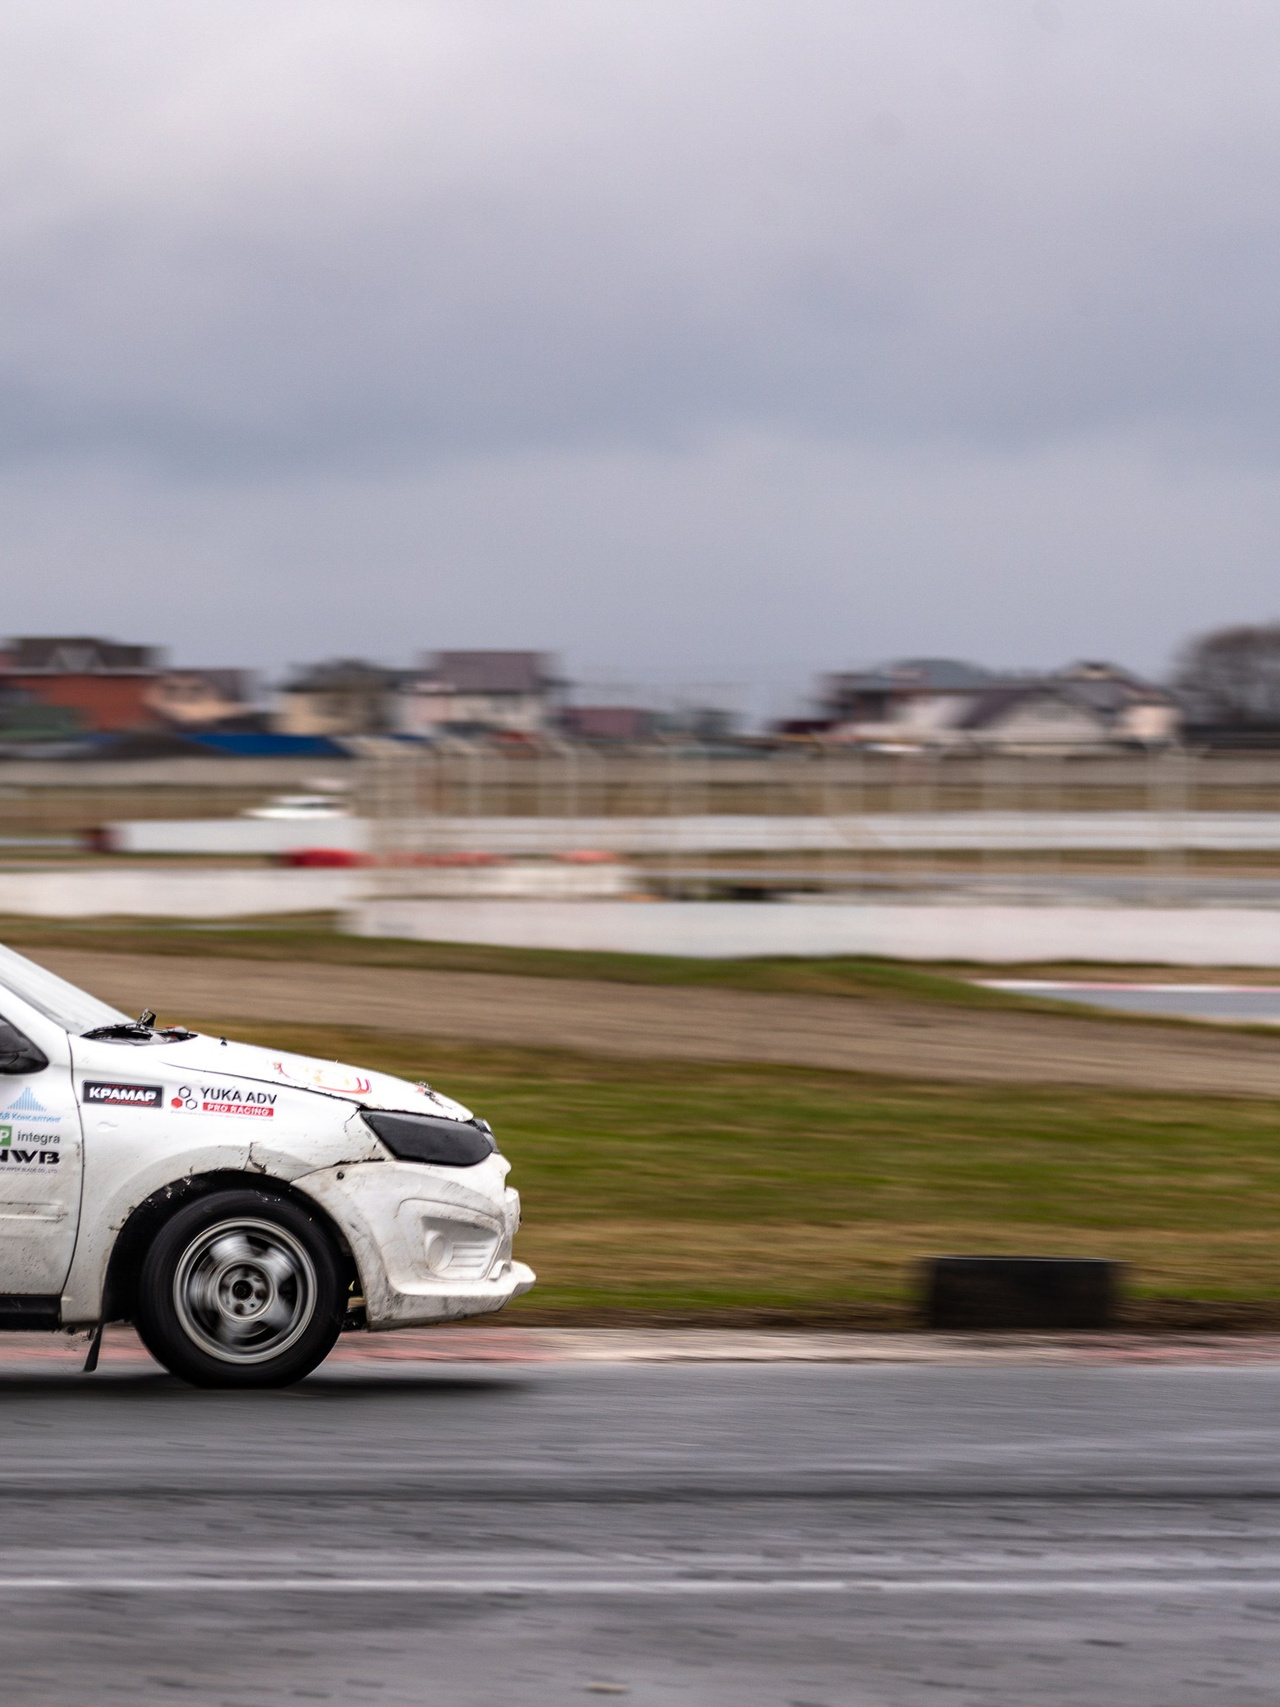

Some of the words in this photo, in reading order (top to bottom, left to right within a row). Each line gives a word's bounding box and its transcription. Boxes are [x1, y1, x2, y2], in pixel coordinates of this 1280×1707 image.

[89, 1087, 157, 1102] КРАМАР
[200, 1087, 242, 1102] YUKA
[245, 1092, 277, 1105] ADV
[207, 1104, 228, 1113] PRO
[230, 1106, 270, 1116] RACING
[17, 1131, 61, 1145] integra
